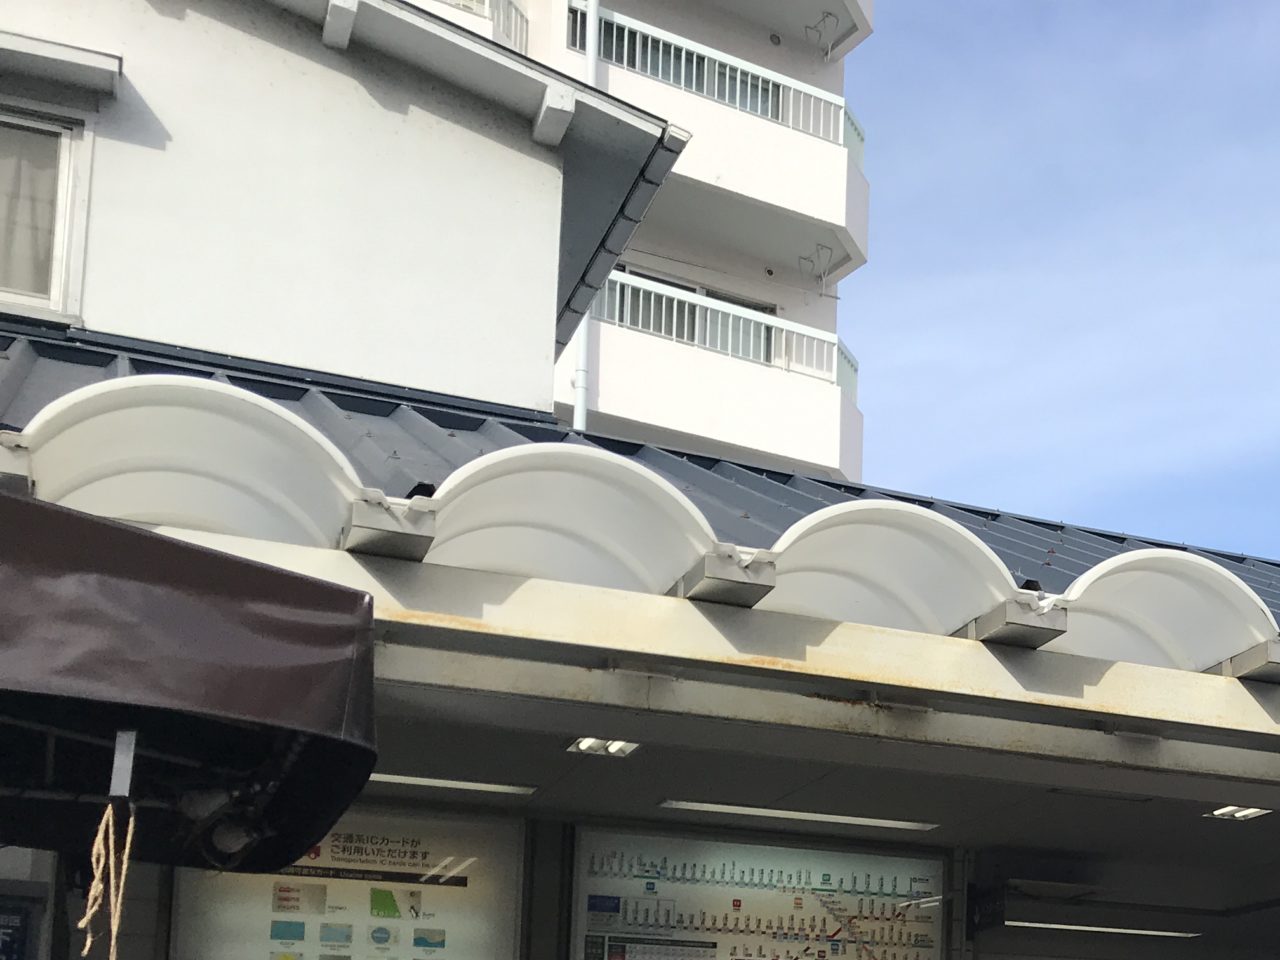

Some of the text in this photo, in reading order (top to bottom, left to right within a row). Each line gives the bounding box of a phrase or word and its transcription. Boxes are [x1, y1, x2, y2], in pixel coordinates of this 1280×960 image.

[330, 845, 430, 860] ご利用いただけます
